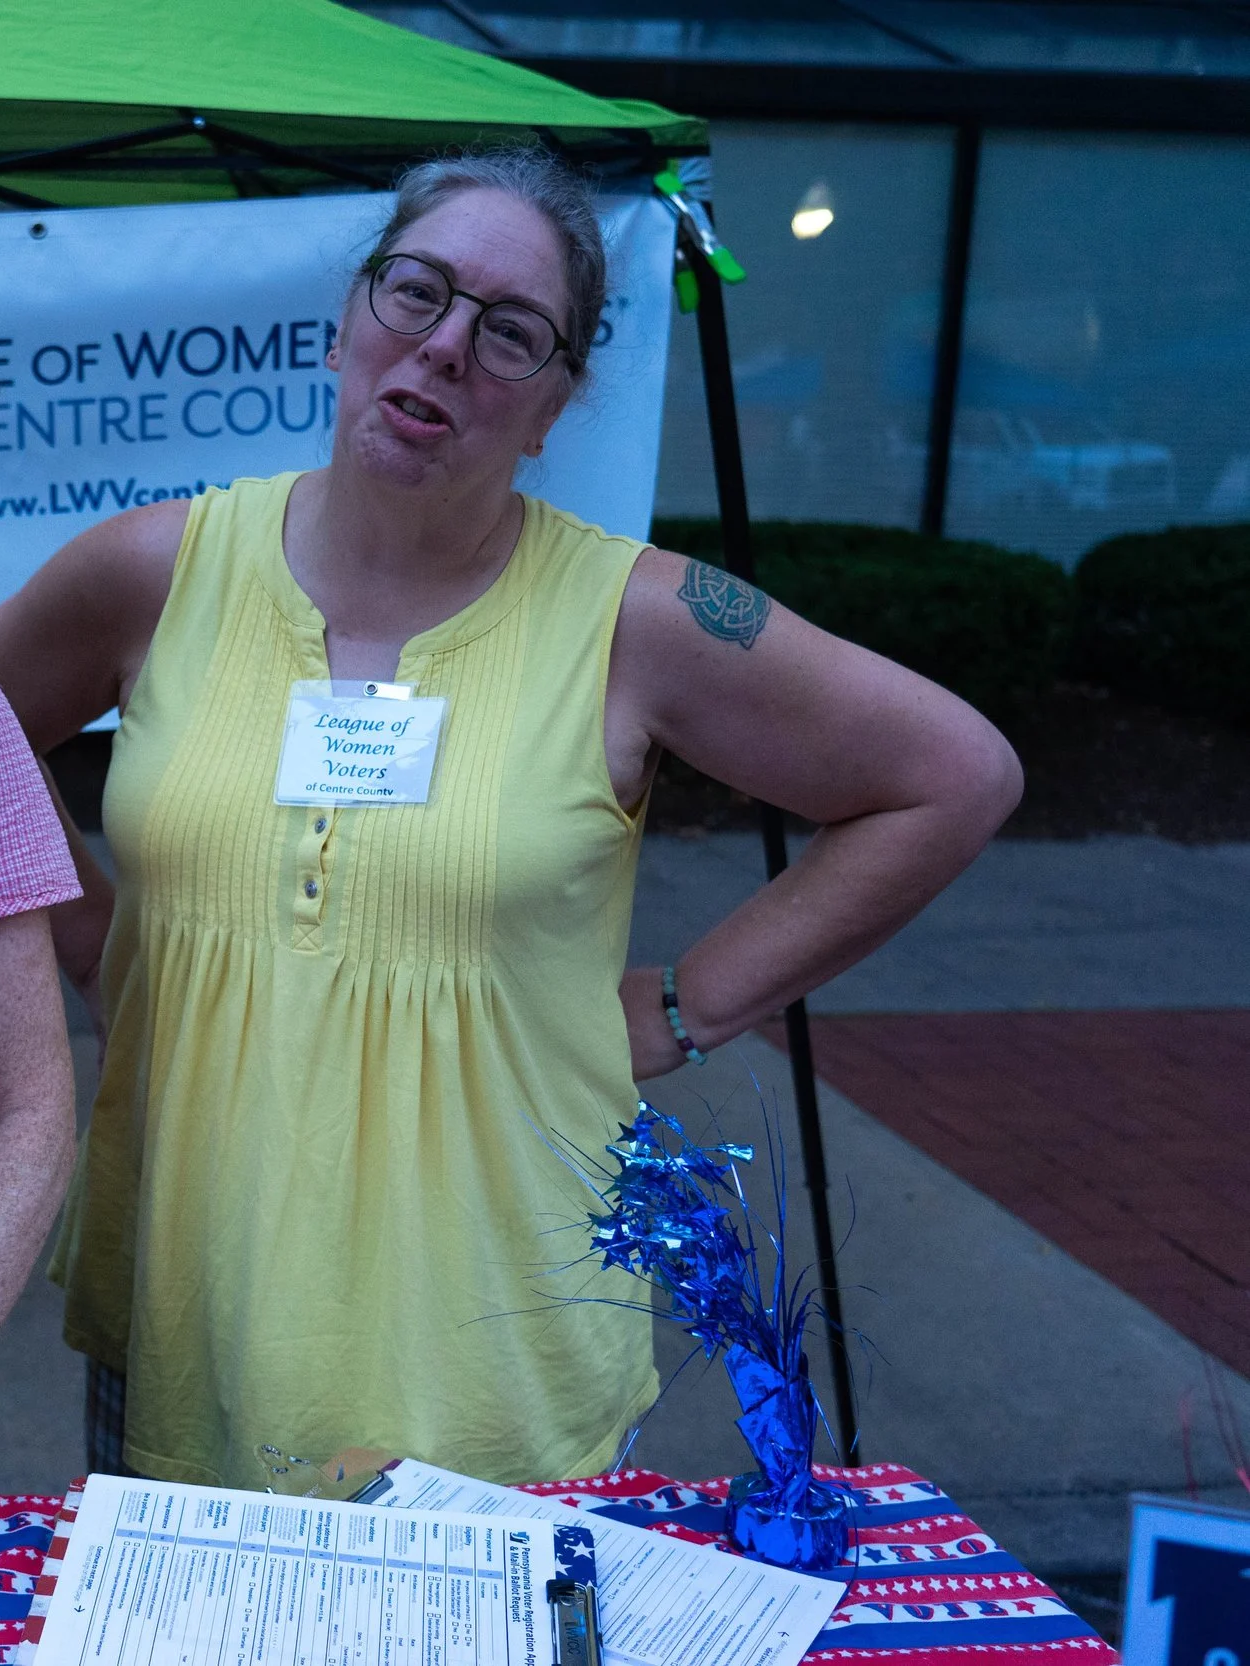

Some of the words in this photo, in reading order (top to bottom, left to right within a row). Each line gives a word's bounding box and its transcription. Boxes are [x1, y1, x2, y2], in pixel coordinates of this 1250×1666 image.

[32, 343, 101, 386] OF
[314, 714, 385, 735] League
[391, 716, 415, 737] of
[322, 735, 396, 756] Women
[322, 759, 388, 780] Voters
[306, 782, 317, 792] of
[319, 783, 354, 795] Centre
[356, 785, 394, 797] County
[164, 1495, 173, 1508] Voting
[205, 1499, 215, 1517] changed
[221, 1505, 230, 1514] your
[137, 1509, 146, 1523] worker
[160, 1508, 170, 1528] assistance
[219, 1514, 228, 1526] name
[260, 1505, 269, 1520] Political
[323, 1511, 332, 1527] Mailing
[259, 1521, 267, 1532] party
[298, 1509, 307, 1536] Identification
[313, 1522, 322, 1545] registration
[322, 1527, 330, 1543] address
[91, 1545, 103, 1564] Continue
[889, 1537, 1006, 1563] OTE
[507, 1551, 518, 1575] Mail-in
[519, 1546, 532, 1590] Pennsylvania
[87, 1569, 97, 1579] next
[84, 1579, 94, 1590] page.
[508, 1575, 519, 1595] Ballot
[509, 1595, 521, 1623] Request
[521, 1590, 533, 1609] Voter
[871, 1600, 1006, 1621] VOTE
[521, 1609, 536, 1652] Registration
[524, 1652, 536, 1666] App
